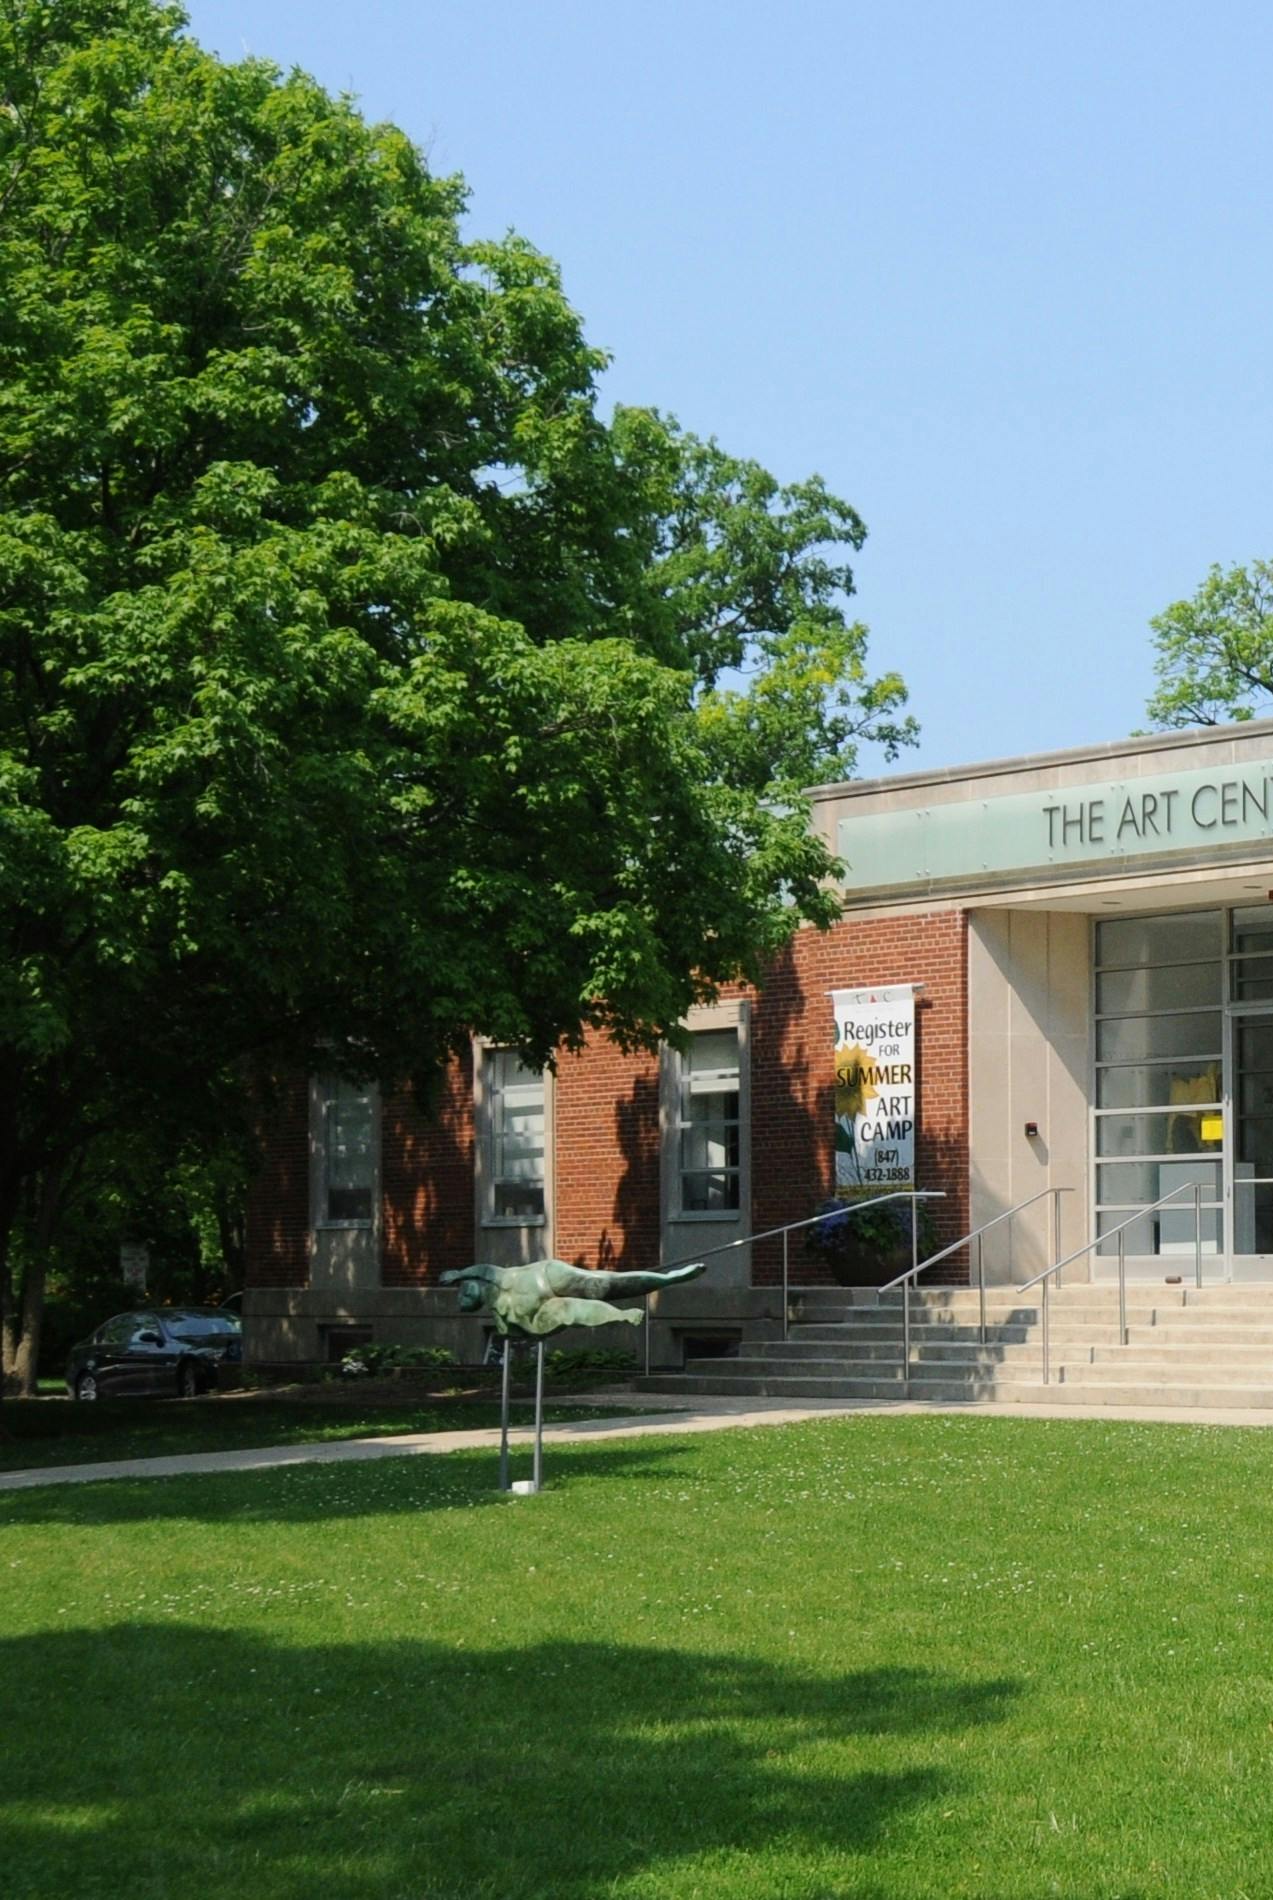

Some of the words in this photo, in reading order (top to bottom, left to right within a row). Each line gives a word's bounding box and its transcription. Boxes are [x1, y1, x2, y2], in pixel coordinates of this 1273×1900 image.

[1042, 800, 1104, 848] THE
[1116, 789, 1180, 840] ART
[844, 1018, 912, 1046] Register
[878, 1044, 900, 1057] FOR
[837, 1064, 912, 1088] SUMMER
[876, 1096, 912, 1117] ART
[861, 1120, 912, 1142] CAMP
[874, 1149, 899, 1167] (847)
